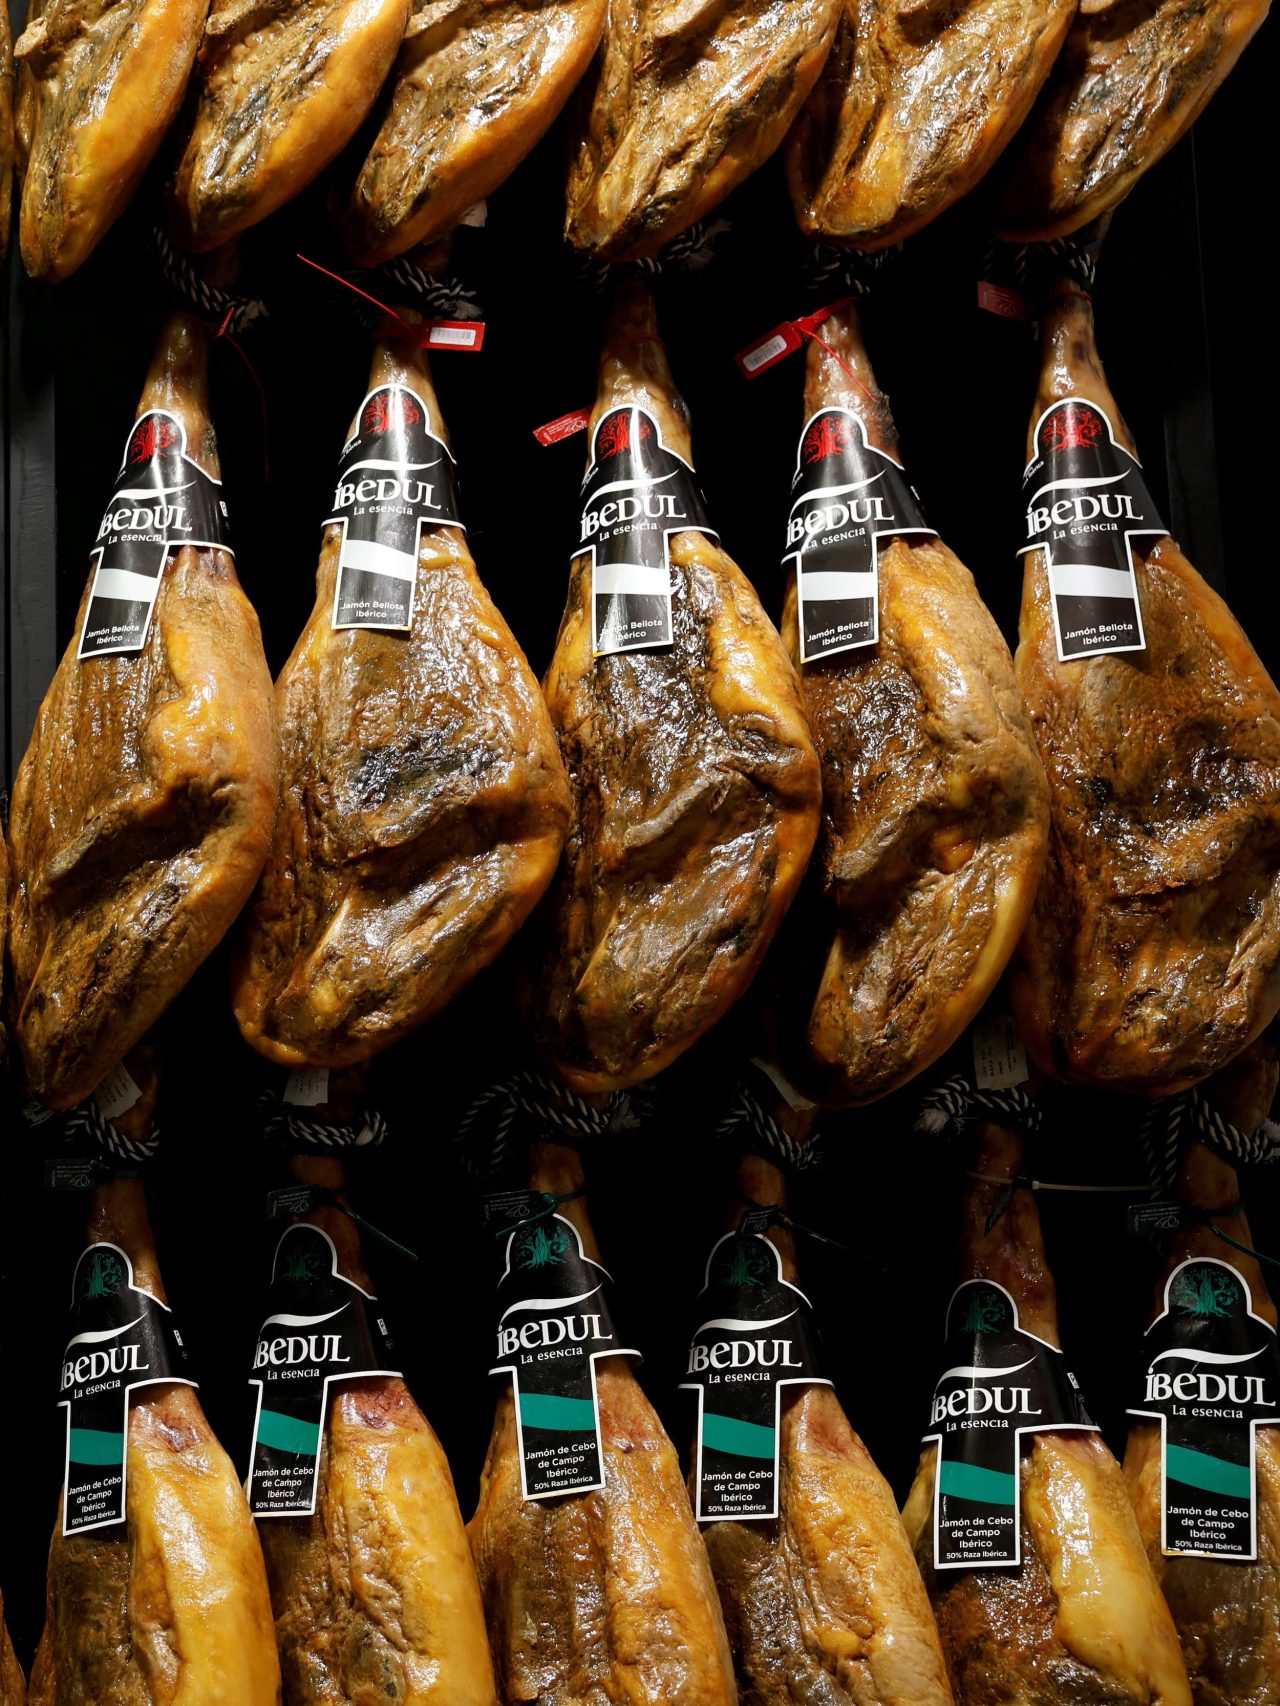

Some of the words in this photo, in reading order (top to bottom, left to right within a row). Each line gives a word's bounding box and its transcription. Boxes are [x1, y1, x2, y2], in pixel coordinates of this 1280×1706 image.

[341, 601, 370, 610] Jamón
[373, 601, 404, 610] Bellota
[356, 610, 387, 618] Ibérico
[630, 619, 663, 630] Bellota
[86, 628, 109, 639] Jamón
[112, 624, 139, 634] Bellota
[807, 628, 835, 642] Jamón
[837, 621, 869, 633] Bellota
[1065, 627, 1096, 639] Jamón
[1099, 622, 1133, 632] Bellota
[97, 635, 122, 644] Ibérico
[822, 632, 852, 646] Ibérico
[1083, 633, 1117, 645] Ibérico
[521, 1353, 533, 1365] La
[267, 1370, 278, 1380] La
[709, 1374, 720, 1384] La
[74, 1388, 84, 1399] La
[1172, 1405, 1186, 1416] La
[946, 1422, 956, 1432] La
[526, 1448, 555, 1460] Jamón
[557, 1446, 569, 1455] de
[571, 1441, 596, 1452] Cebo
[538, 1460, 549, 1468] de
[552, 1454, 585, 1466] Campo
[546, 1466, 578, 1478] Ibérico
[703, 1472, 732, 1481] Jamón
[749, 1470, 773, 1478] Cebo
[714, 1483, 725, 1491] de
[728, 1481, 760, 1491] Campo
[721, 1493, 752, 1502] Ibérico
[1168, 1506, 1202, 1516] Jamón
[1205, 1508, 1218, 1517] de
[1221, 1509, 1249, 1518] Cebo
[940, 1518, 970, 1528] Jamón
[973, 1518, 984, 1526] de
[987, 1517, 1013, 1525] Cebo
[1181, 1518, 1195, 1527] de
[1197, 1519, 1235, 1529] Campo
[952, 1529, 963, 1537] de
[966, 1528, 1000, 1538] Campo
[1190, 1530, 1226, 1539] Ibérico
[959, 1540, 992, 1548] Ibérico
